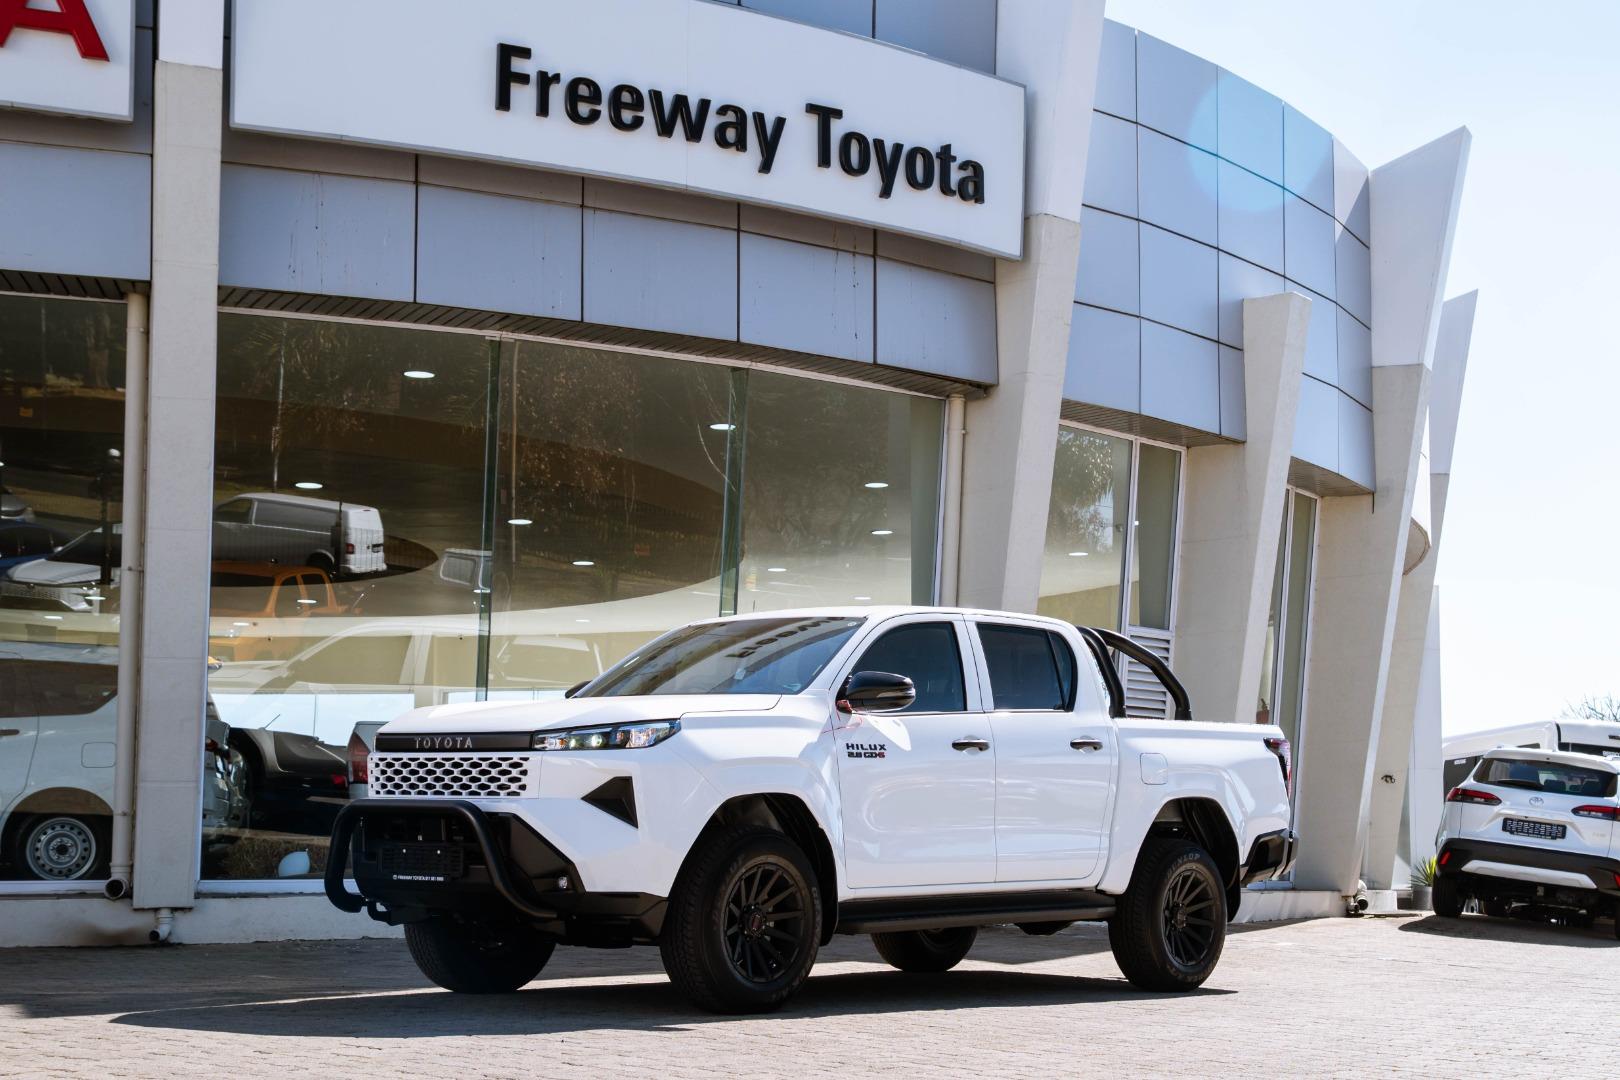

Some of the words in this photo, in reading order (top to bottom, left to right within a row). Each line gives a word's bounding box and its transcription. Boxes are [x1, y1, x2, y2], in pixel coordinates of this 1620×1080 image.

[495, 43, 786, 174] Freeway
[805, 103, 985, 204] Toyota
[414, 736, 473, 749] TOYOTA
[846, 743, 887, 751] HILUX
